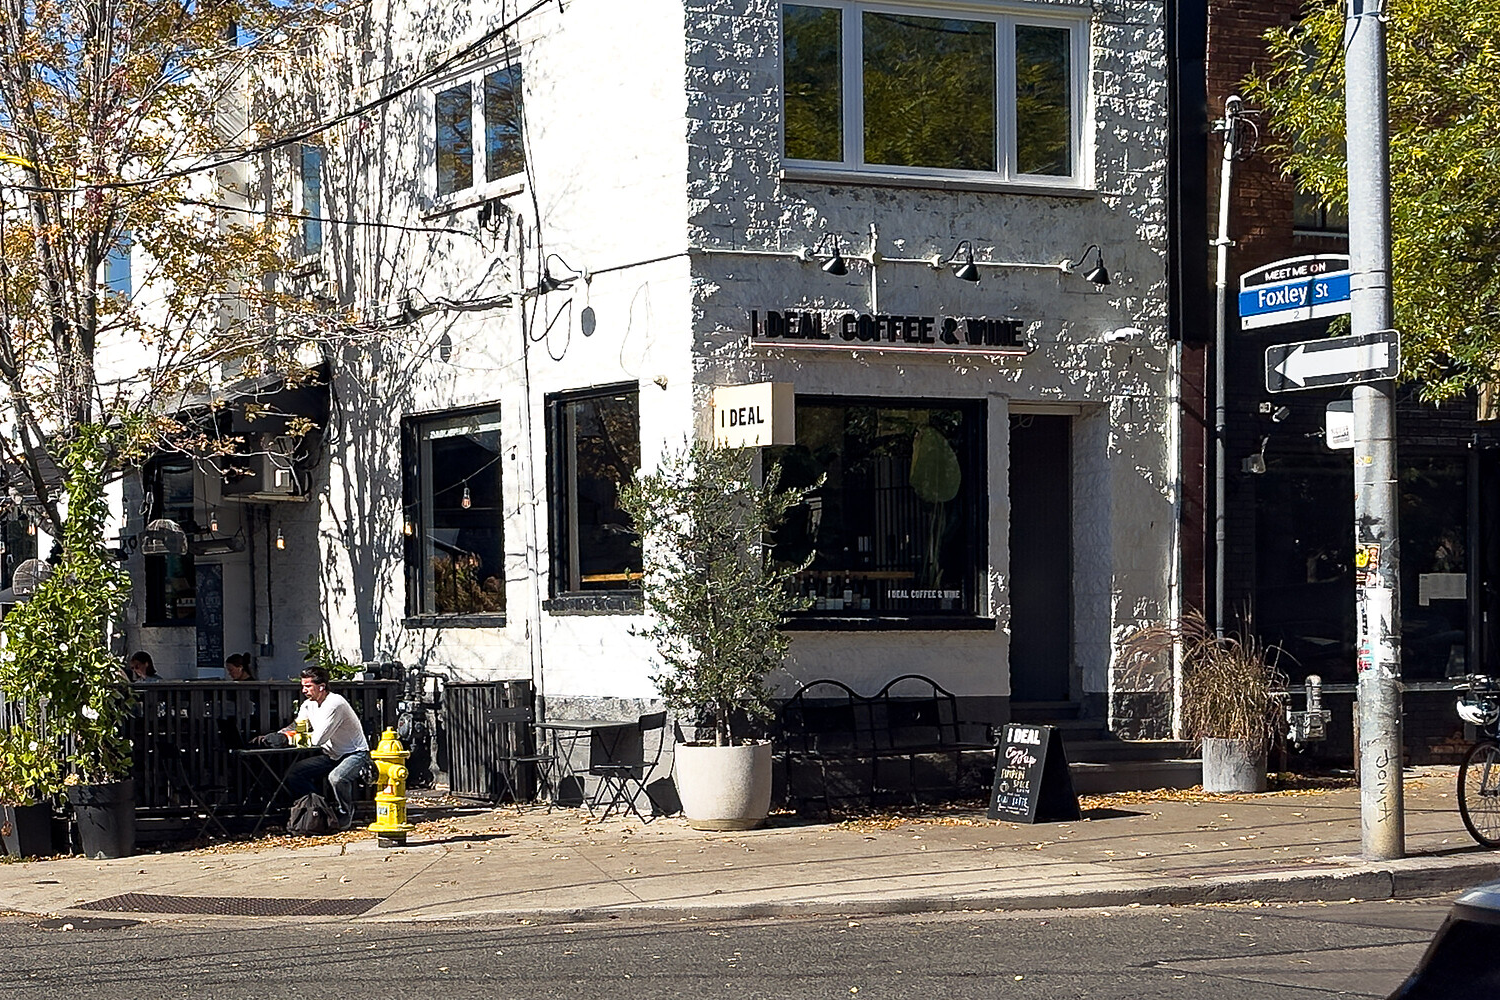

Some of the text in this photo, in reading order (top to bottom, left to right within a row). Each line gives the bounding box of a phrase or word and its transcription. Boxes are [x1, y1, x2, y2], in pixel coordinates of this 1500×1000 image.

[1265, 262, 1326, 281] MEET ME ON
[1258, 283, 1329, 308] Foxley St
[751, 309, 1024, 347] I DEAL COFFEE & WINE
[721, 405, 765, 428] I DEAL
[910, 589, 937, 599] COFFEE
[1007, 728, 1041, 746] I DEAL
